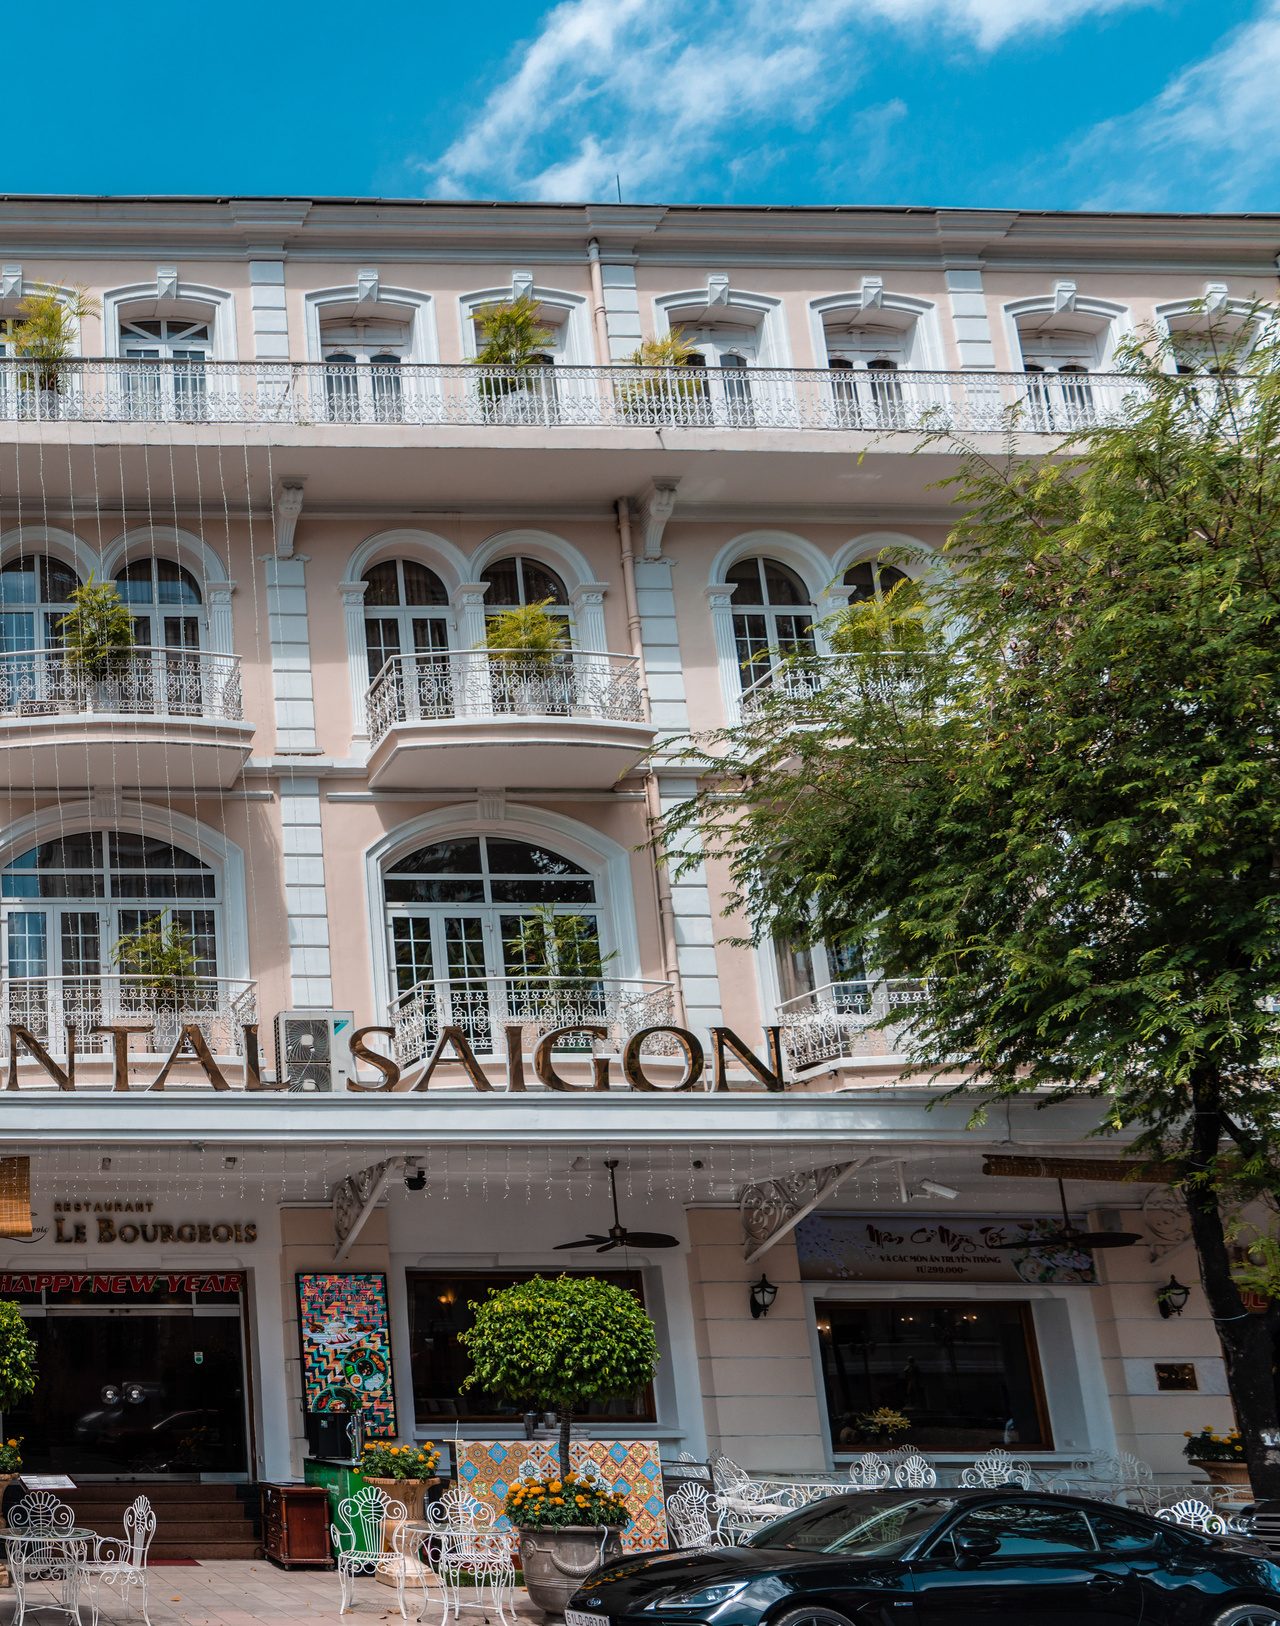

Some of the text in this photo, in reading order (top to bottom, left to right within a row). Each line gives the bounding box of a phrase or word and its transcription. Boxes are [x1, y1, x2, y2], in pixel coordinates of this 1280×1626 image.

[347, 1026, 784, 1092] SAIGON
[54, 1202, 154, 1213] RESTAURANT
[92, 1274, 158, 1293] NEW
[167, 1274, 243, 1293] YEAR
[303, 1282, 328, 1290] NEW
[304, 1294, 337, 1302] LUNCH
